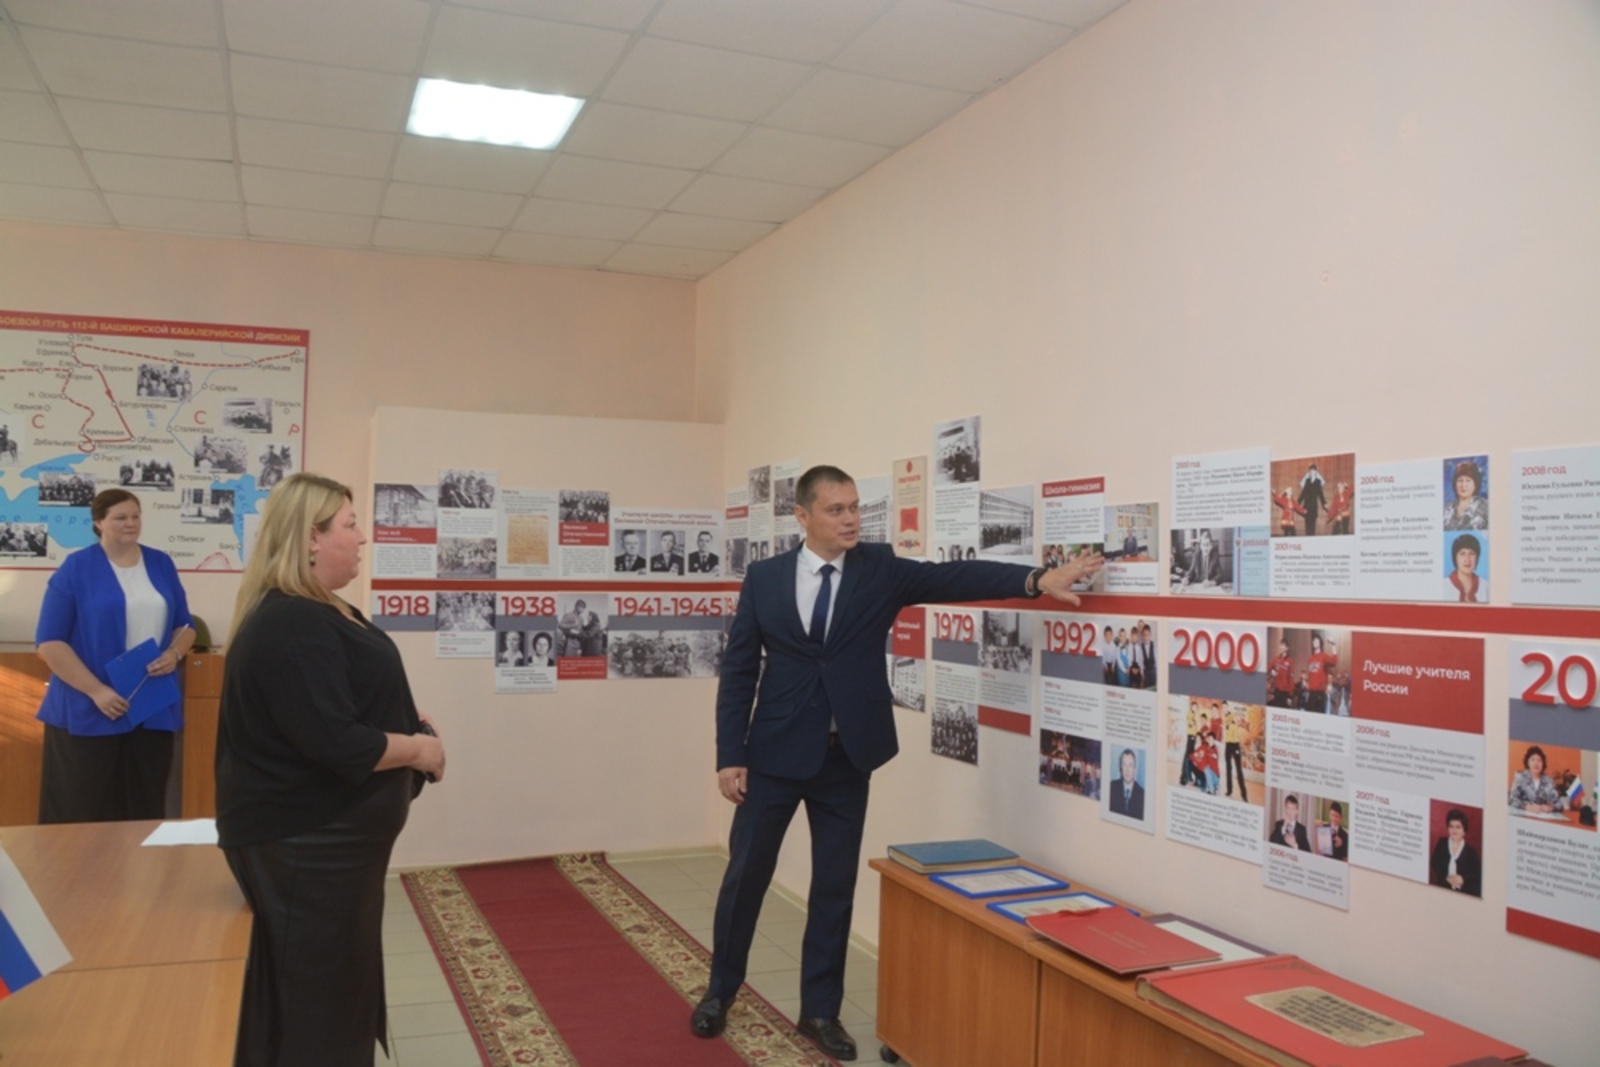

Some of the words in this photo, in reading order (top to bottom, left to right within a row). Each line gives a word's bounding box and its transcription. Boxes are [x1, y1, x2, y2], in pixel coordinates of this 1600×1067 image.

[43, 319, 69, 328] ПУТЬ
[72, 320, 97, 330] 112-Й
[100, 322, 168, 334] БАШКИРСКОЙ
[171, 326, 254, 339] КАВАЛЕРИЙСКОЙ
[256, 332, 301, 342] ДИВИЗИИ
[1547, 465, 1566, 475] год
[377, 595, 430, 617] 1918
[501, 596, 556, 618] 1938
[614, 596, 722, 618] 1941-1945
[934, 612, 975, 643] 1979
[1043, 620, 1097, 656] 1992
[1173, 628, 1260, 673] 2000
[1363, 660, 1413, 675] Лучшие
[1415, 666, 1471, 681] учителя
[1520, 652, 1597, 709] 20
[1363, 680, 1409, 696] России
[1376, 728, 1390, 738] год
[1376, 795, 1390, 806] год
